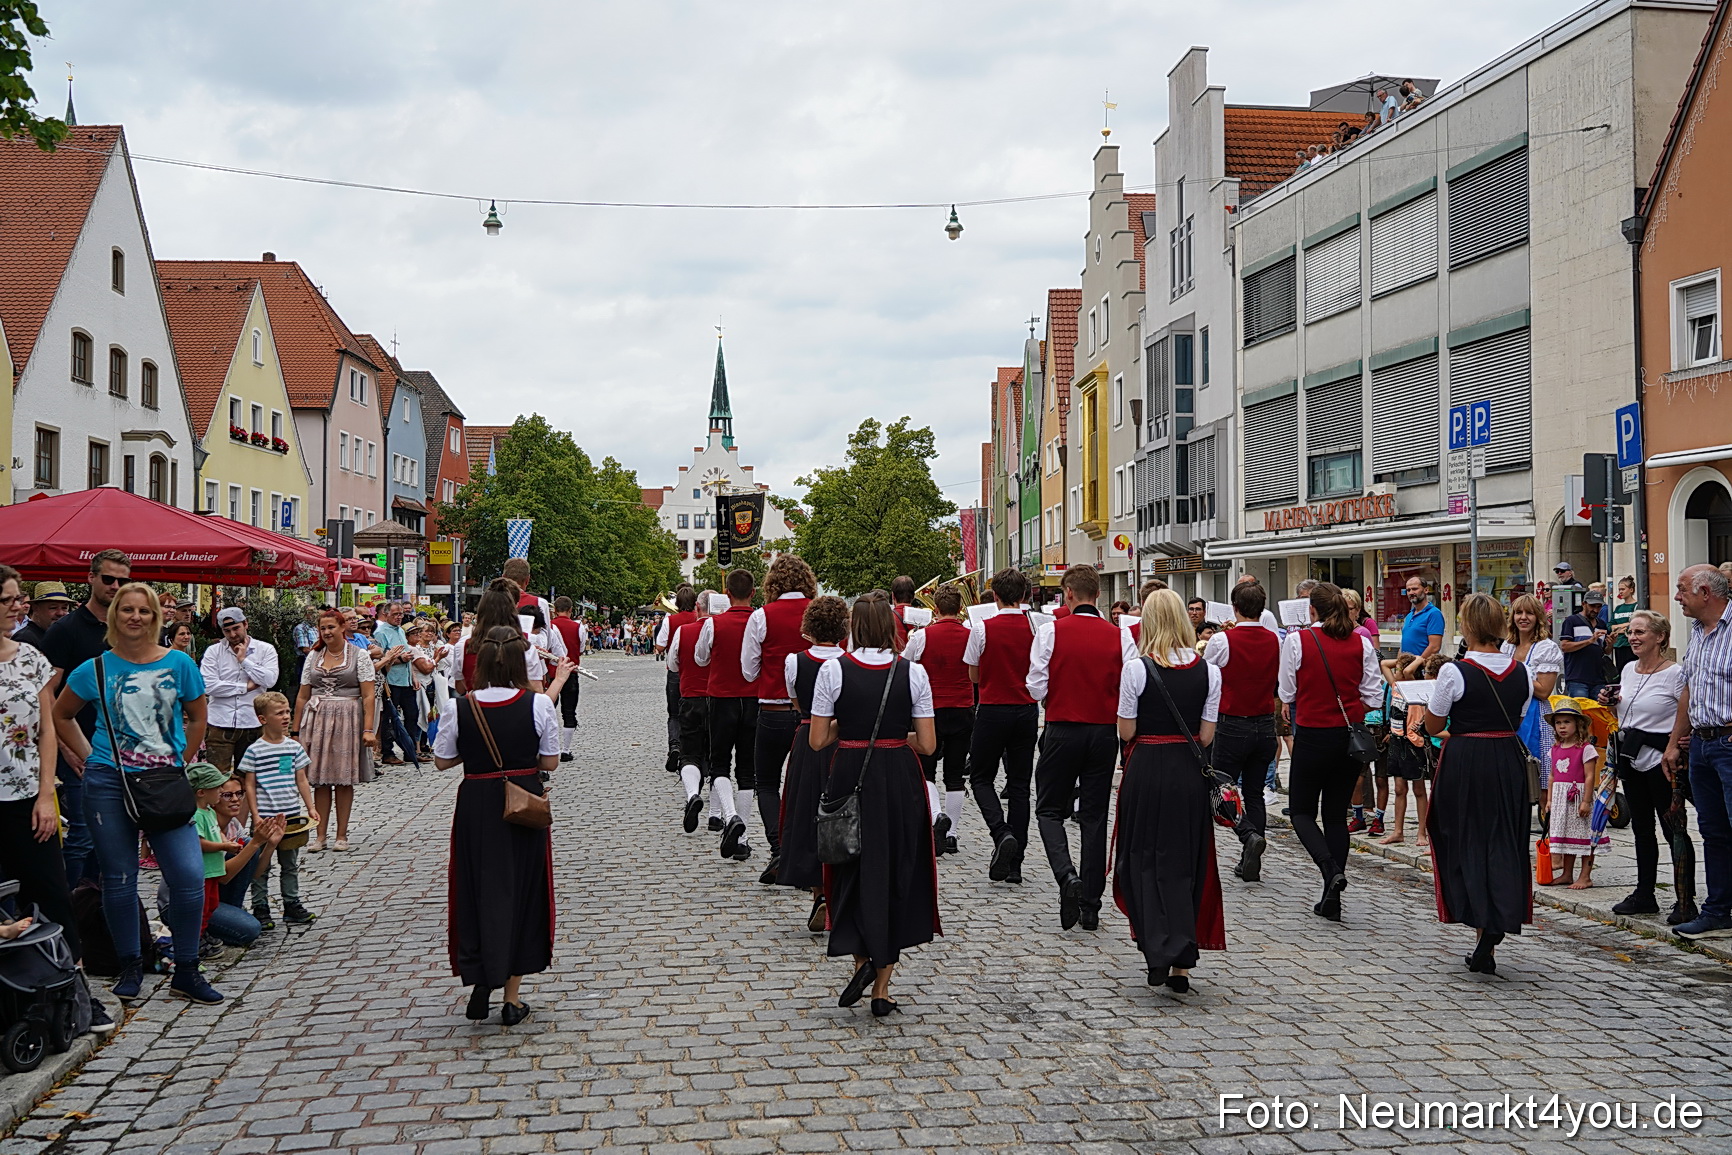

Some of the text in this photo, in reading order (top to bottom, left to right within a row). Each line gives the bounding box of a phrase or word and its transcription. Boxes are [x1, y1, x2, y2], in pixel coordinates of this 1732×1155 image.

[1452, 411, 1464, 445] P
[1474, 406, 1487, 441] P
[1620, 412, 1635, 460] P
[283, 504, 290, 527] P
[1263, 493, 1395, 531] MARIEN-APOTHEKE
[169, 551, 219, 562] Lehmeier
[1458, 541, 1519, 553] MARN APOTHEKE
[1654, 552, 1665, 564] 39
